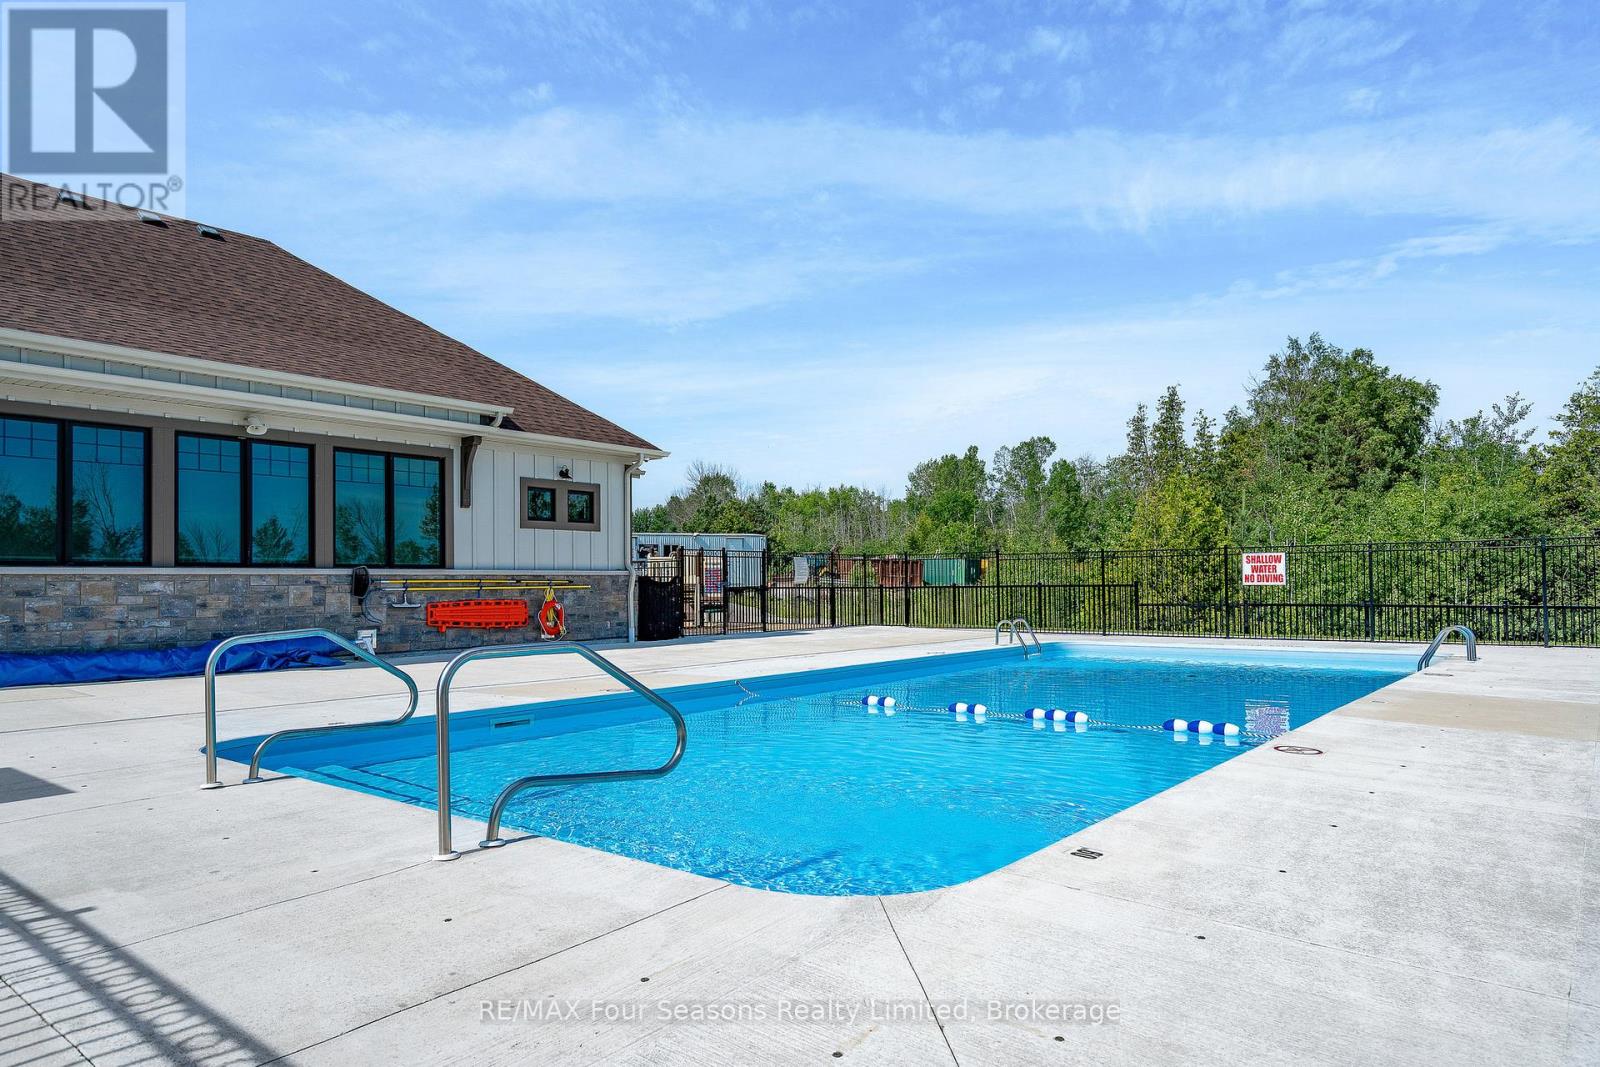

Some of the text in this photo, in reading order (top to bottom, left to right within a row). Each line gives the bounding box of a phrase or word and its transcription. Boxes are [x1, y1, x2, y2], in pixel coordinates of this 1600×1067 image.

[1245, 555, 1282, 564] SHALLOW
[1251, 565, 1277, 573] WATER
[1244, 574, 1284, 583] NO DIVING
